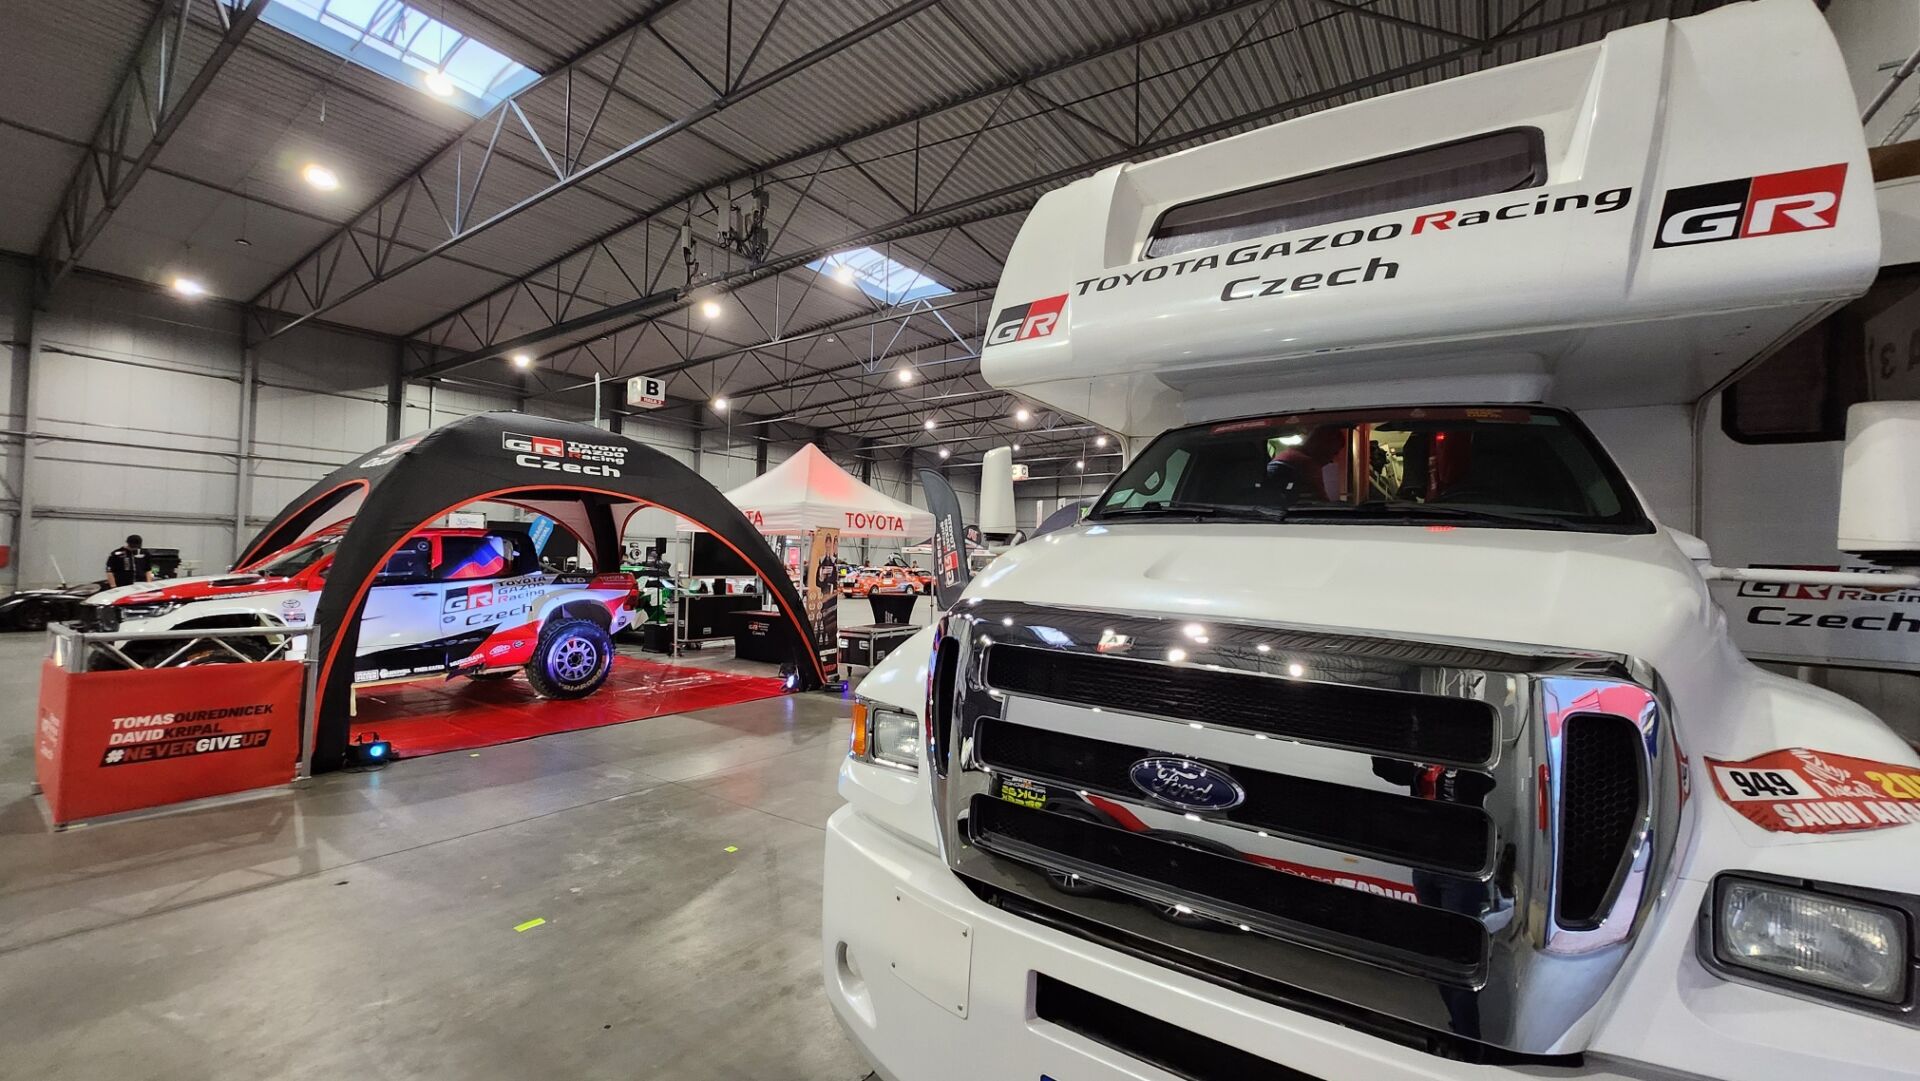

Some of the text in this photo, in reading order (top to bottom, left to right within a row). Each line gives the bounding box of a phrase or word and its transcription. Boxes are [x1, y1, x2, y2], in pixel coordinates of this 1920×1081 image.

[1660, 189, 1839, 245] GR
[1076, 186, 1633, 296] TOYOTA GAZOO Racing
[1220, 257, 1400, 302] Czech
[988, 310, 1058, 345] GR
[646, 379, 659, 396] B
[505, 439, 562, 457] GR
[566, 441, 628, 453] TOYOTA
[567, 447, 625, 458] GAZOO
[569, 452, 625, 465] Racing
[516, 454, 621, 478] Czech
[845, 512, 905, 531] TOYOTA
[498, 582, 545, 595] GAZOO
[499, 576, 547, 587] TOYOTA
[445, 591, 493, 614] GR
[498, 588, 545, 604] Racing
[465, 604, 534, 627] Czech
[1747, 605, 1920, 633] Czech
[105, 733, 267, 764] #NEVERGIVEUP
[1154, 767, 1214, 799] Ford
[1728, 770, 1799, 797] 949
[1773, 801, 1873, 828] SAUDI
